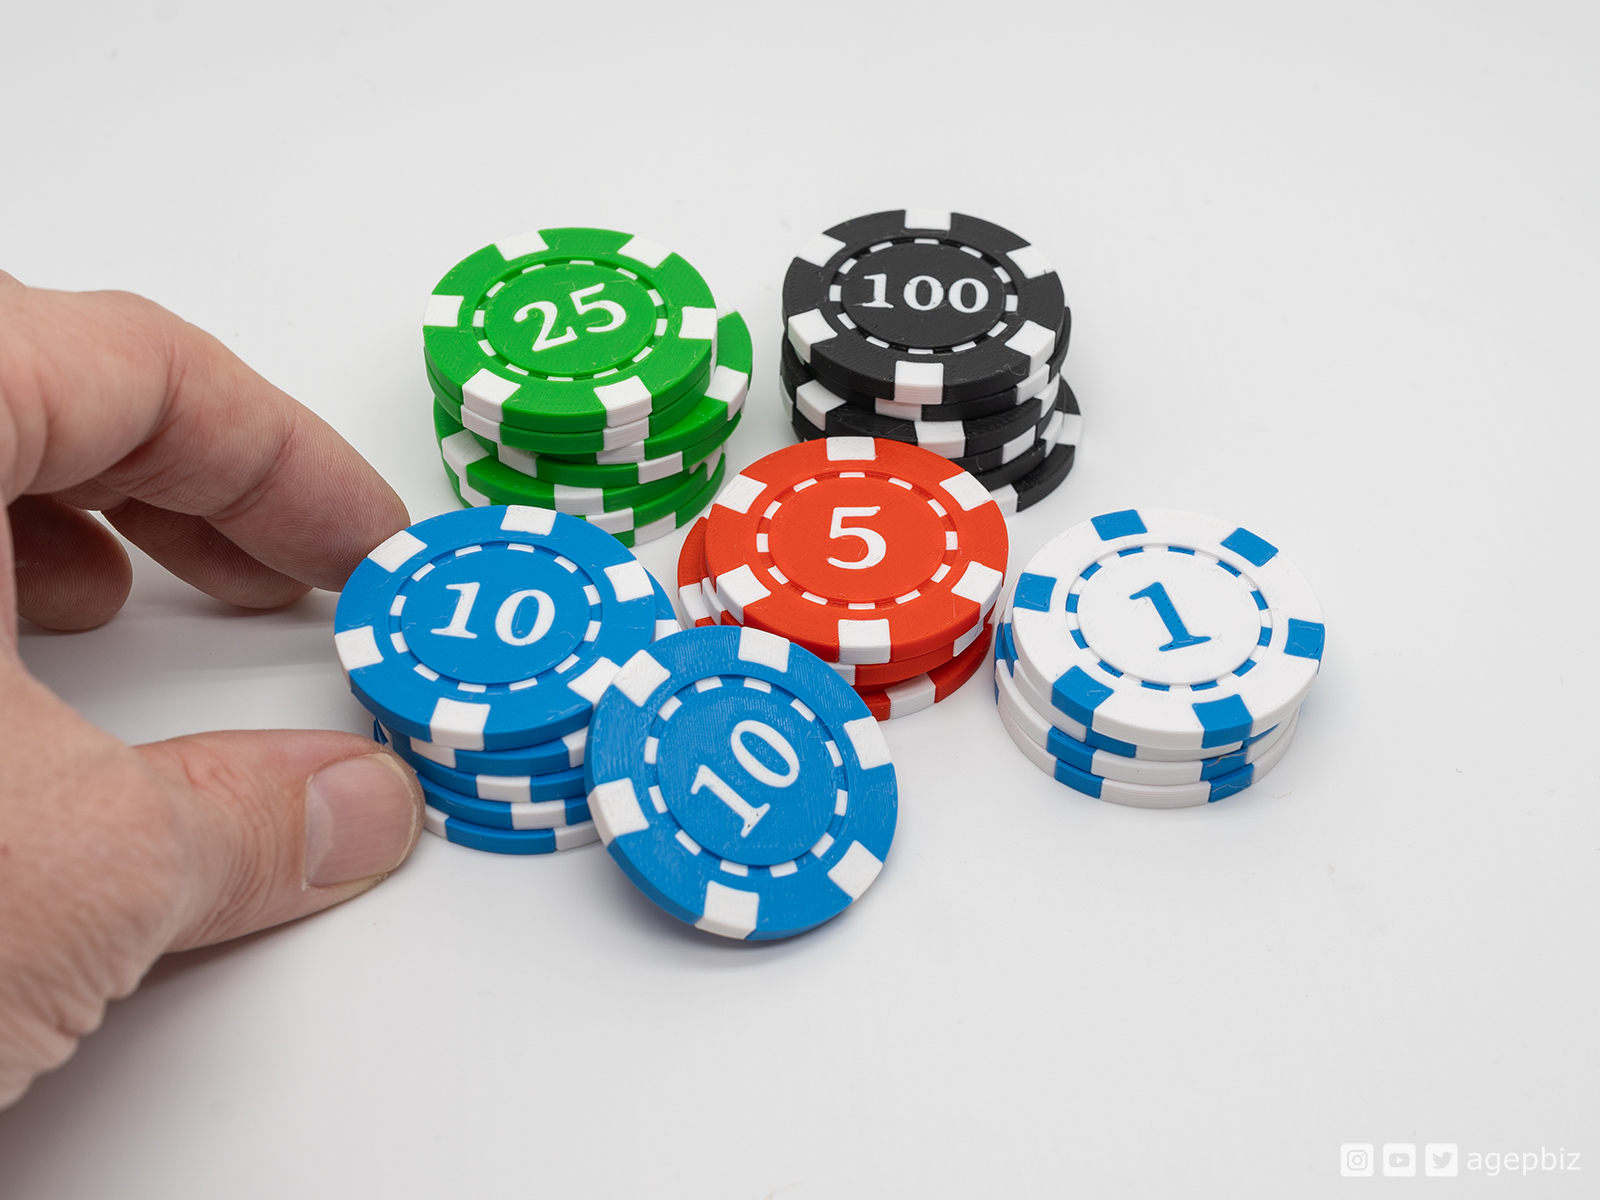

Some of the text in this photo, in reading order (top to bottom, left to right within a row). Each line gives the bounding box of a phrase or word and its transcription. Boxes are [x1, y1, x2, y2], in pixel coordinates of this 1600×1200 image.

[512, 282, 627, 352] 25
[861, 272, 990, 314] 100
[826, 505, 888, 570] 5
[430, 581, 556, 648] 10
[1129, 581, 1212, 652] 1
[690, 719, 801, 838] 10
